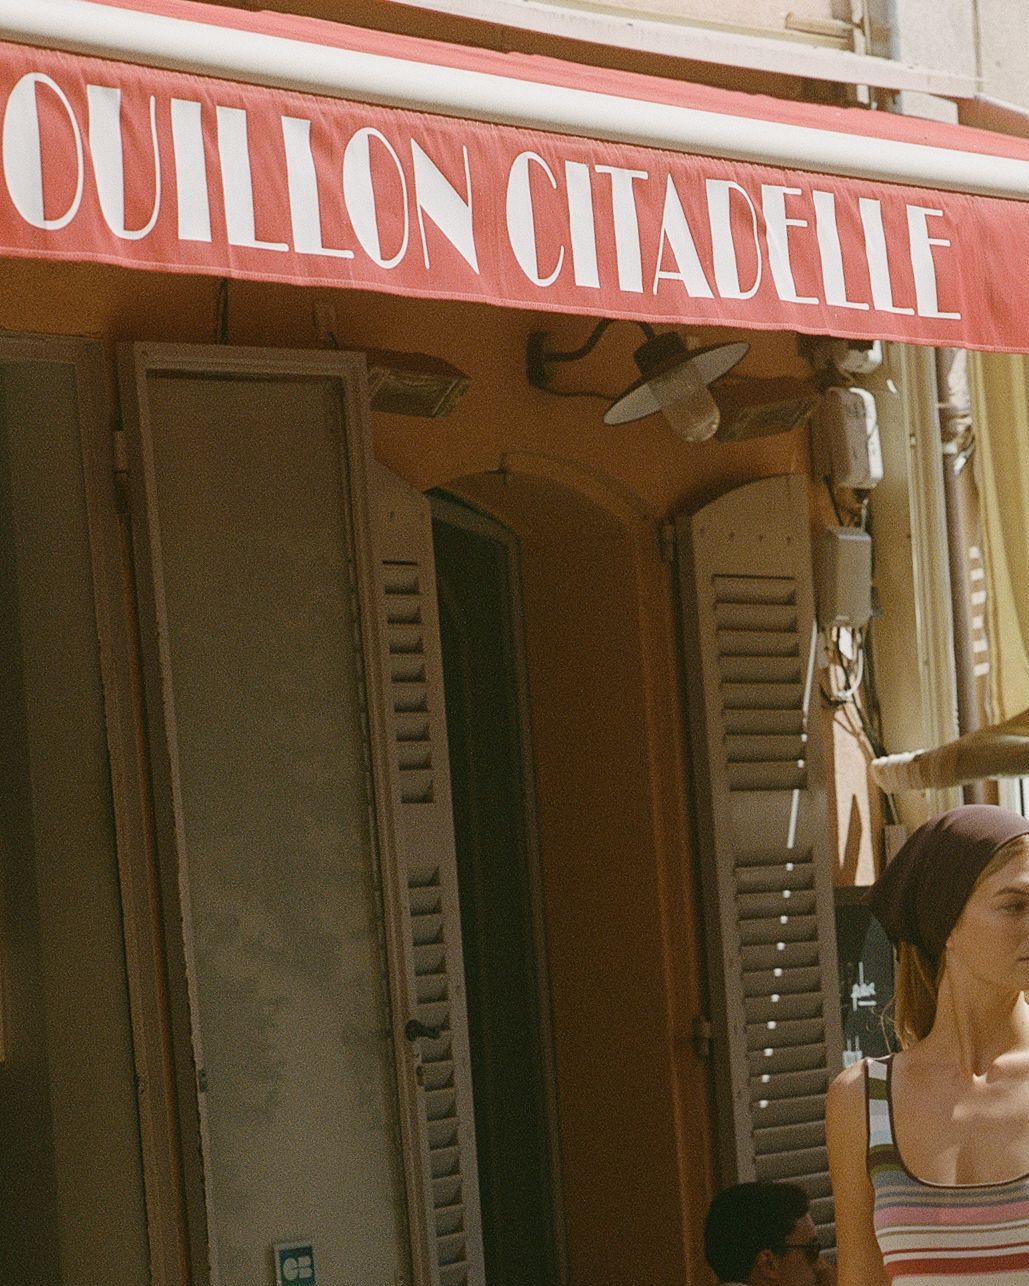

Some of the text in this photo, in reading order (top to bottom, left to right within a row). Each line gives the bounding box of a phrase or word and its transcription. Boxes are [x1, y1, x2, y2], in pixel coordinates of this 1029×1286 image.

[2, 72, 962, 320] OUILLON CITADELLE
[283, 1255, 313, 1281] CB
